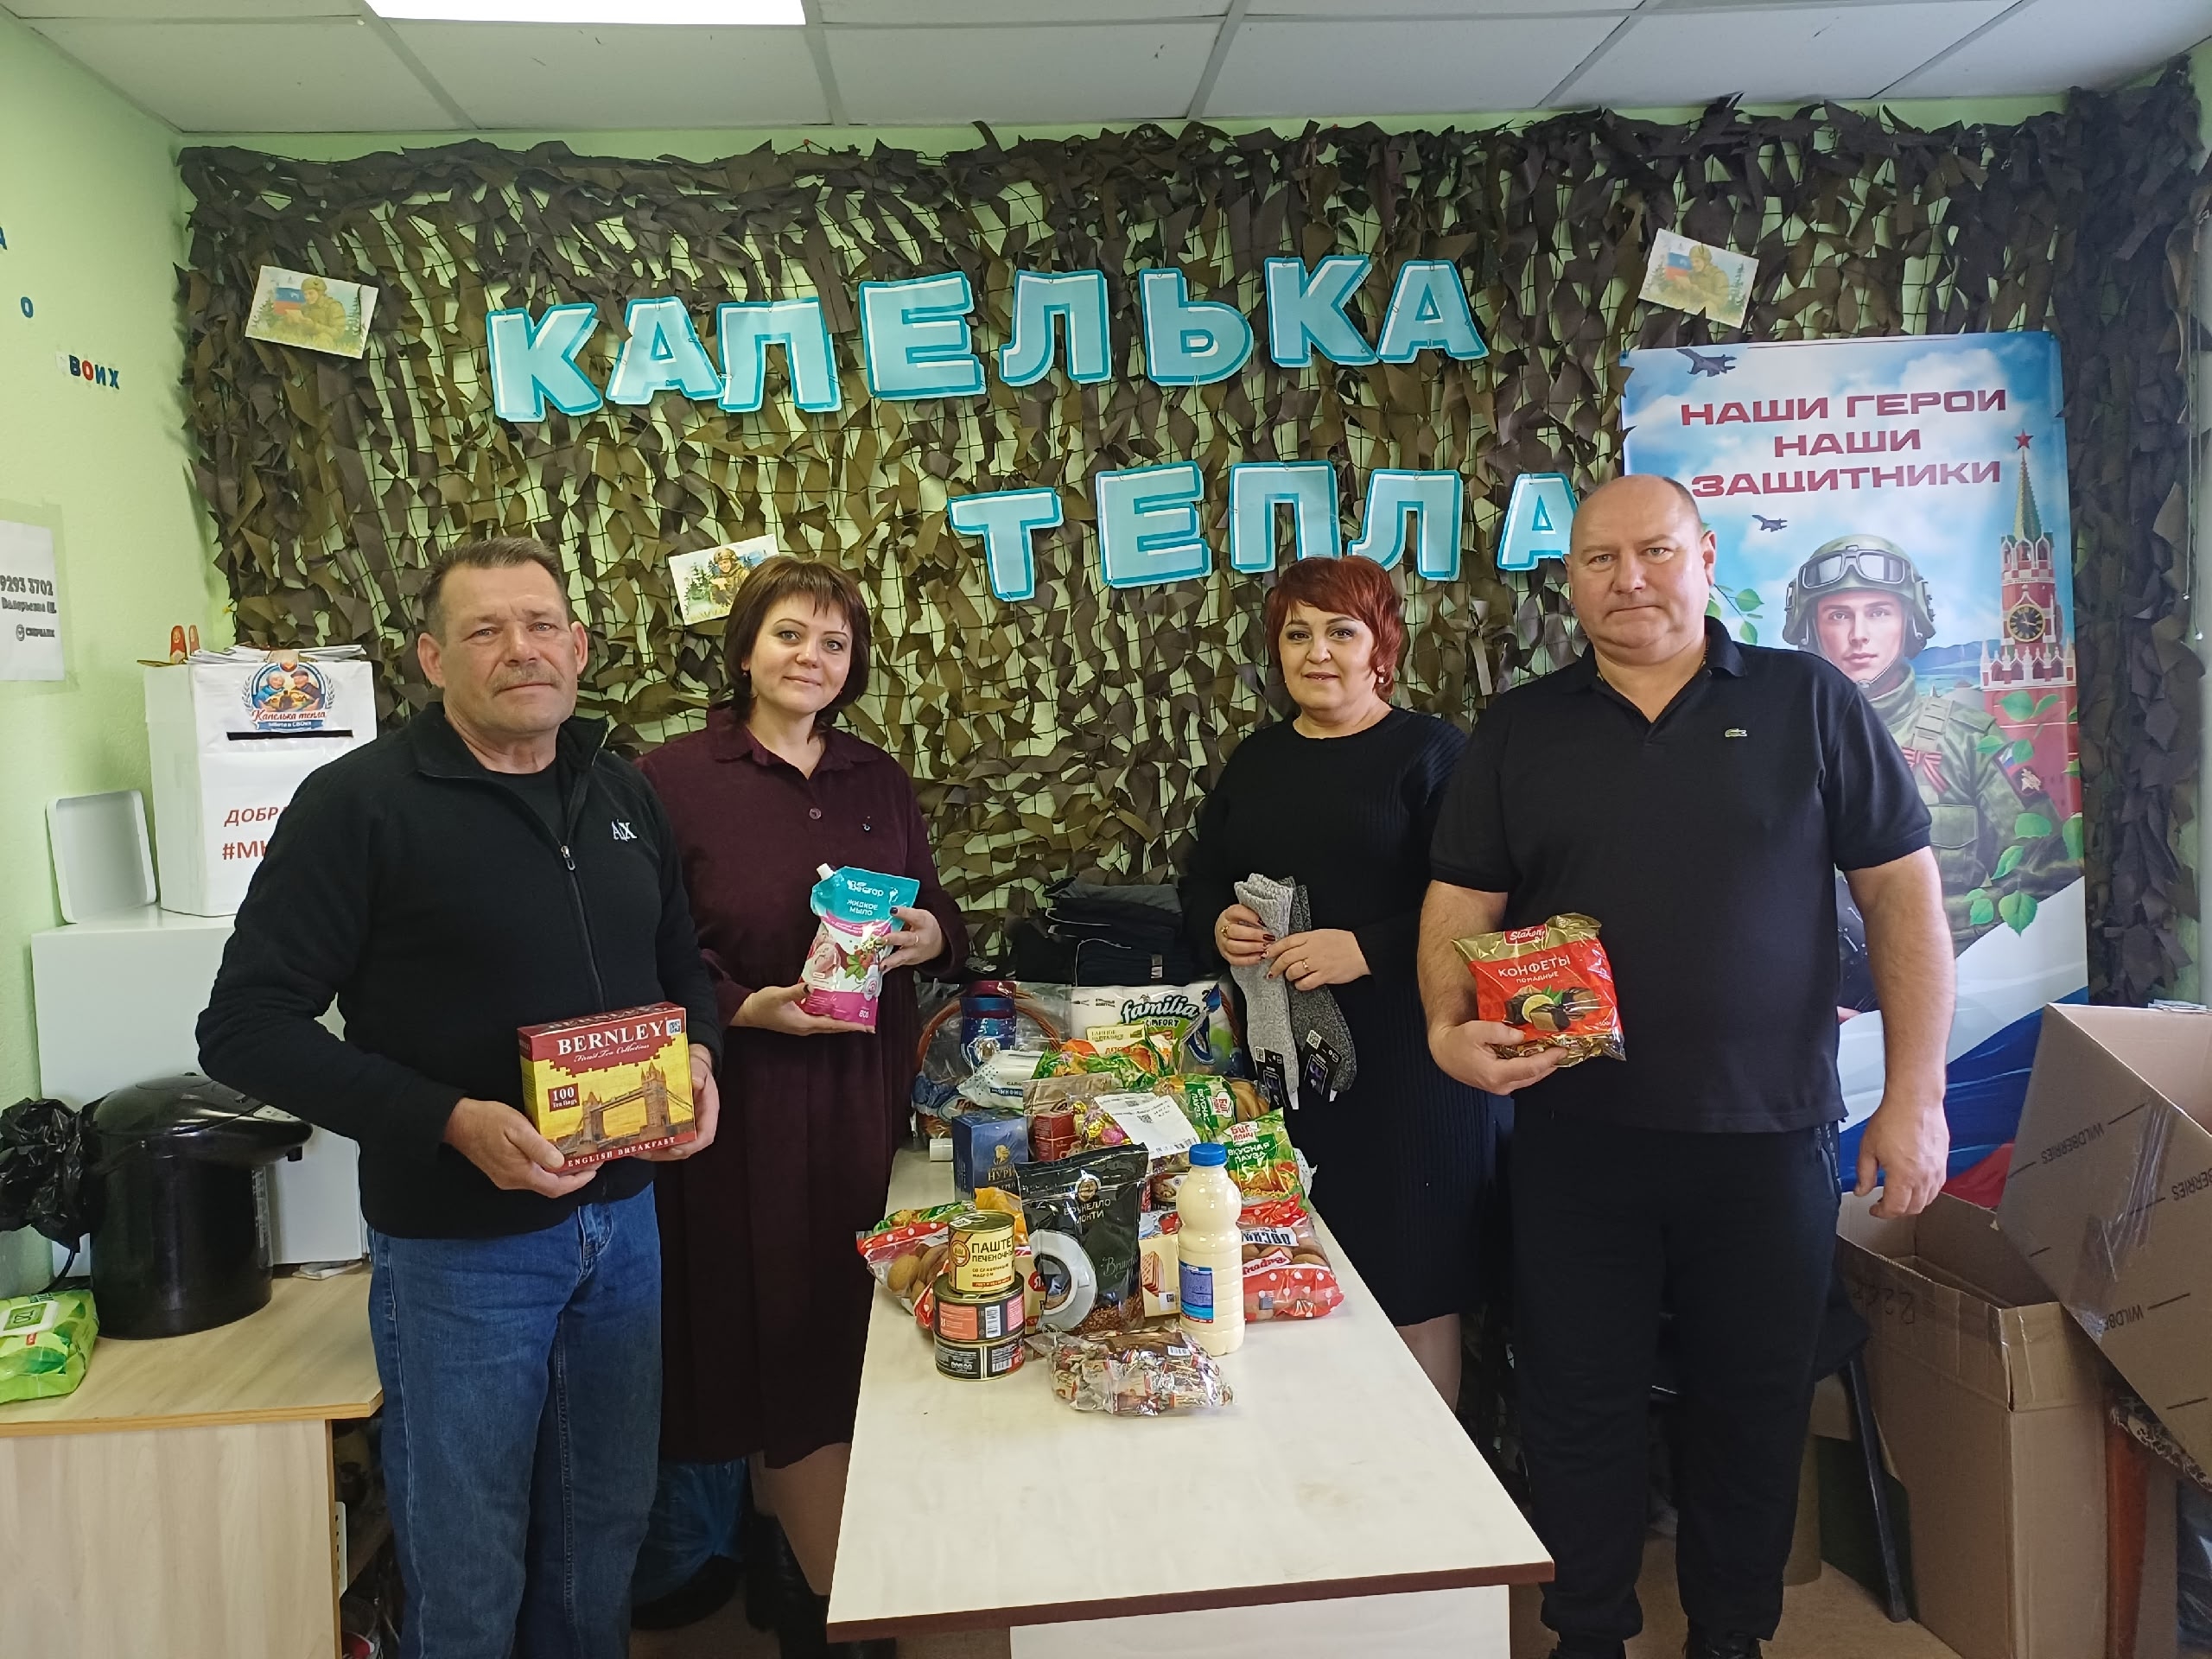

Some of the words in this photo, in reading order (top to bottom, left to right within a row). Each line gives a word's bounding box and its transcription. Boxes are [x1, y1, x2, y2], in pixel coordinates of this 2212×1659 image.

[486, 255, 1490, 423] КАПЕЛЬКА
[69, 355, 119, 390] ВОИХ
[1681, 397, 1828, 426] НАШИ
[1847, 389, 2005, 418] ГЕРОИ
[1774, 429, 1921, 458] НАШИ
[1692, 461, 2000, 498] ЗАЩИТНИКИ
[950, 460, 1579, 602] ТЕПЛА
[1498, 955, 1571, 978] КОНФЕТЫ
[1121, 995, 1201, 1023] familia
[556, 1019, 664, 1056] BERNLEY
[553, 1087, 575, 1102] 100
[568, 1151, 613, 1166] ENGLISH
[618, 1136, 676, 1156] BREAKFAST
[1228, 1142, 1270, 1156] ВКУСНАЯ
[1235, 1151, 1267, 1163] ПАУЗА
[2041, 1122, 2105, 1165] WILDBERRIES
